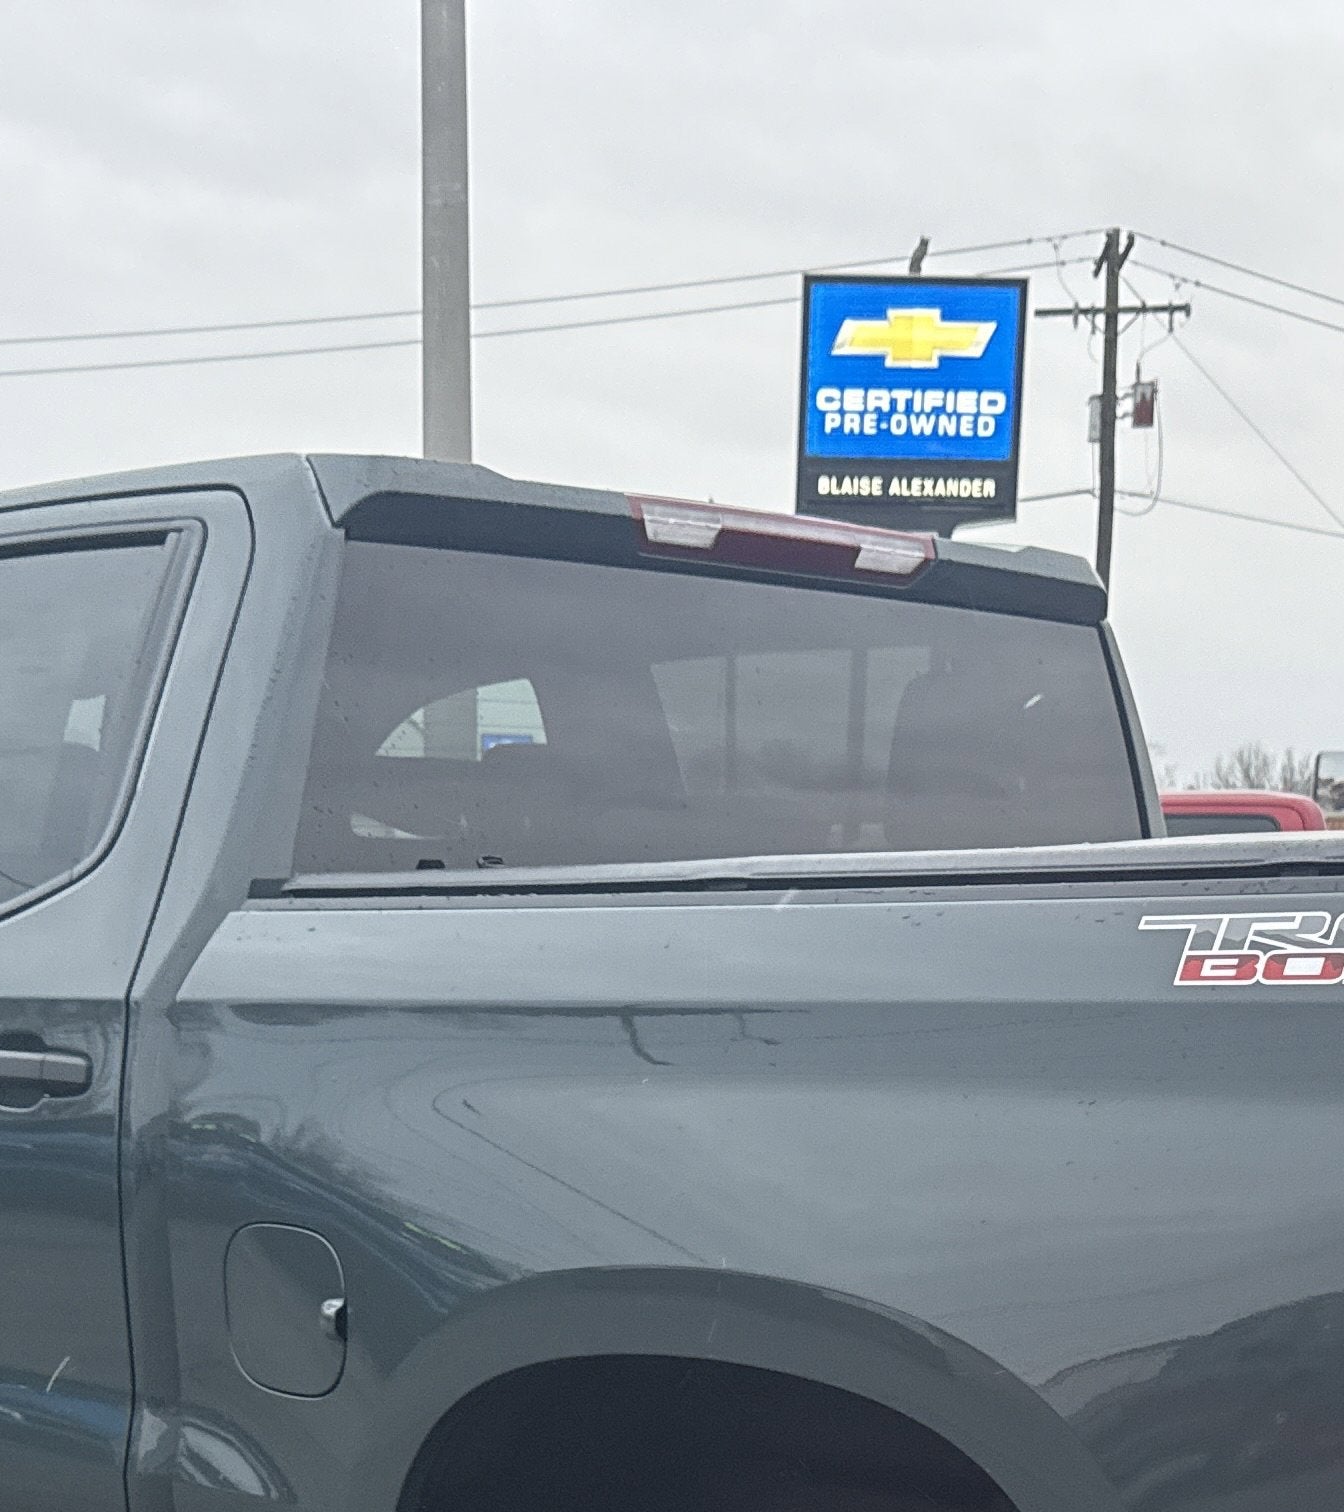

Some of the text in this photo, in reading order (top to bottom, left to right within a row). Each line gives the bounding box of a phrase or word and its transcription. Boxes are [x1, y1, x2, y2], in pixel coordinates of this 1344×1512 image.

[815, 388, 1007, 415] CERTIFIED
[824, 412, 996, 438] PRE-OWNED
[817, 475, 996, 498] BLAISE ALEXANDER
